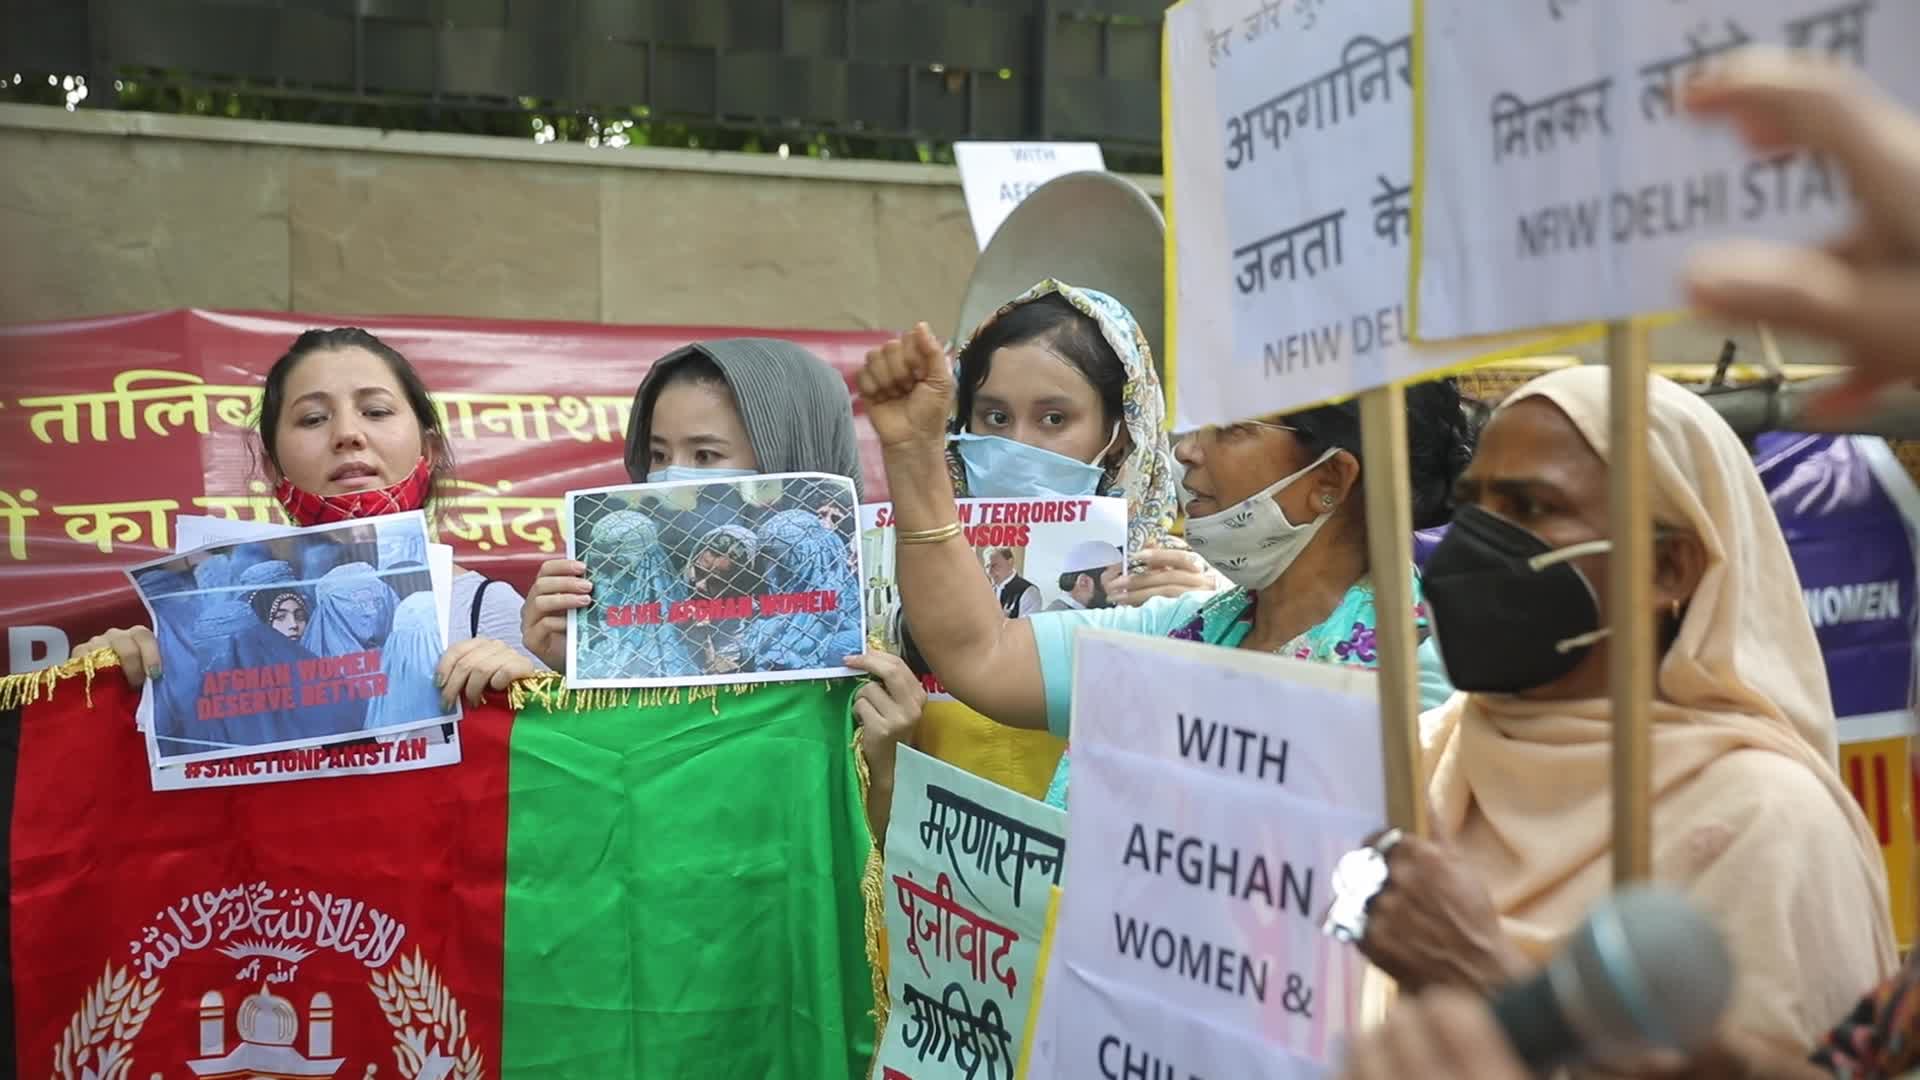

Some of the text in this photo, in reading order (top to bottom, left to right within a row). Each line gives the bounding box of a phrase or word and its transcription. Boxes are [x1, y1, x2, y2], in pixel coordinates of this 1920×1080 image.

[1609, 171, 1729, 244] DELHI
[1739, 148, 1837, 222] STA
[1233, 208, 1347, 294] जनता
[1264, 303, 1410, 380] NFIW DEL
[19, 369, 266, 444] तालिब
[52, 499, 179, 553] का
[979, 500, 1092, 525] TERRORIST
[607, 590, 837, 627] SAVE AFGHAN WOMEN
[197, 673, 389, 721] DESERVE BETTER
[203, 650, 382, 695] AFGHAN WOMEN
[184, 737, 429, 780] #SANCTIONPAKISTAN
[1177, 713, 1289, 784] WITH
[1122, 822, 1318, 917] AFGHAN
[1114, 912, 1314, 1019] WOMEN &
